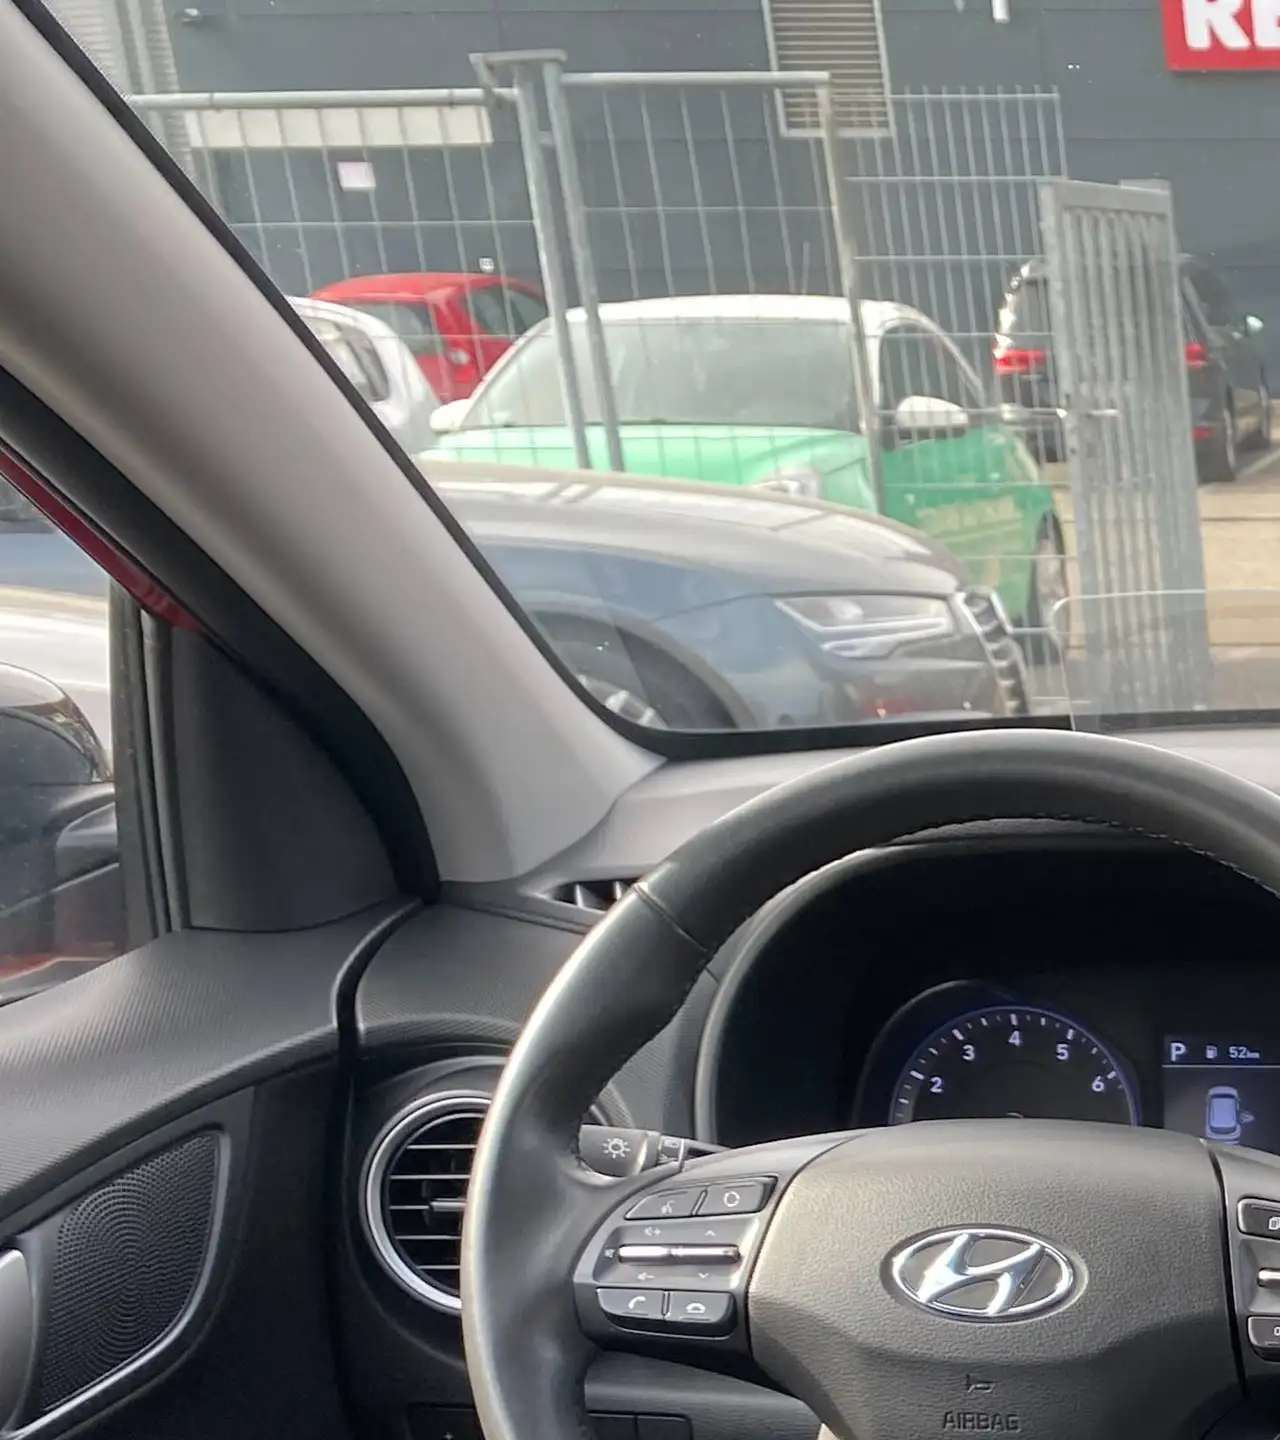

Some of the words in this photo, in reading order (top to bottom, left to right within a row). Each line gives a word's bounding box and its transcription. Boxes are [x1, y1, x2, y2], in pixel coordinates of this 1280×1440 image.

[1008, 1030, 1022, 1047] 4
[962, 1046, 975, 1061] 3
[1056, 1045, 1069, 1061] 5
[1170, 1042, 1187, 1061] P
[929, 1077, 943, 1093] 2
[1091, 1076, 1105, 1092] 6
[942, 1410, 1021, 1432] AIRBAG
